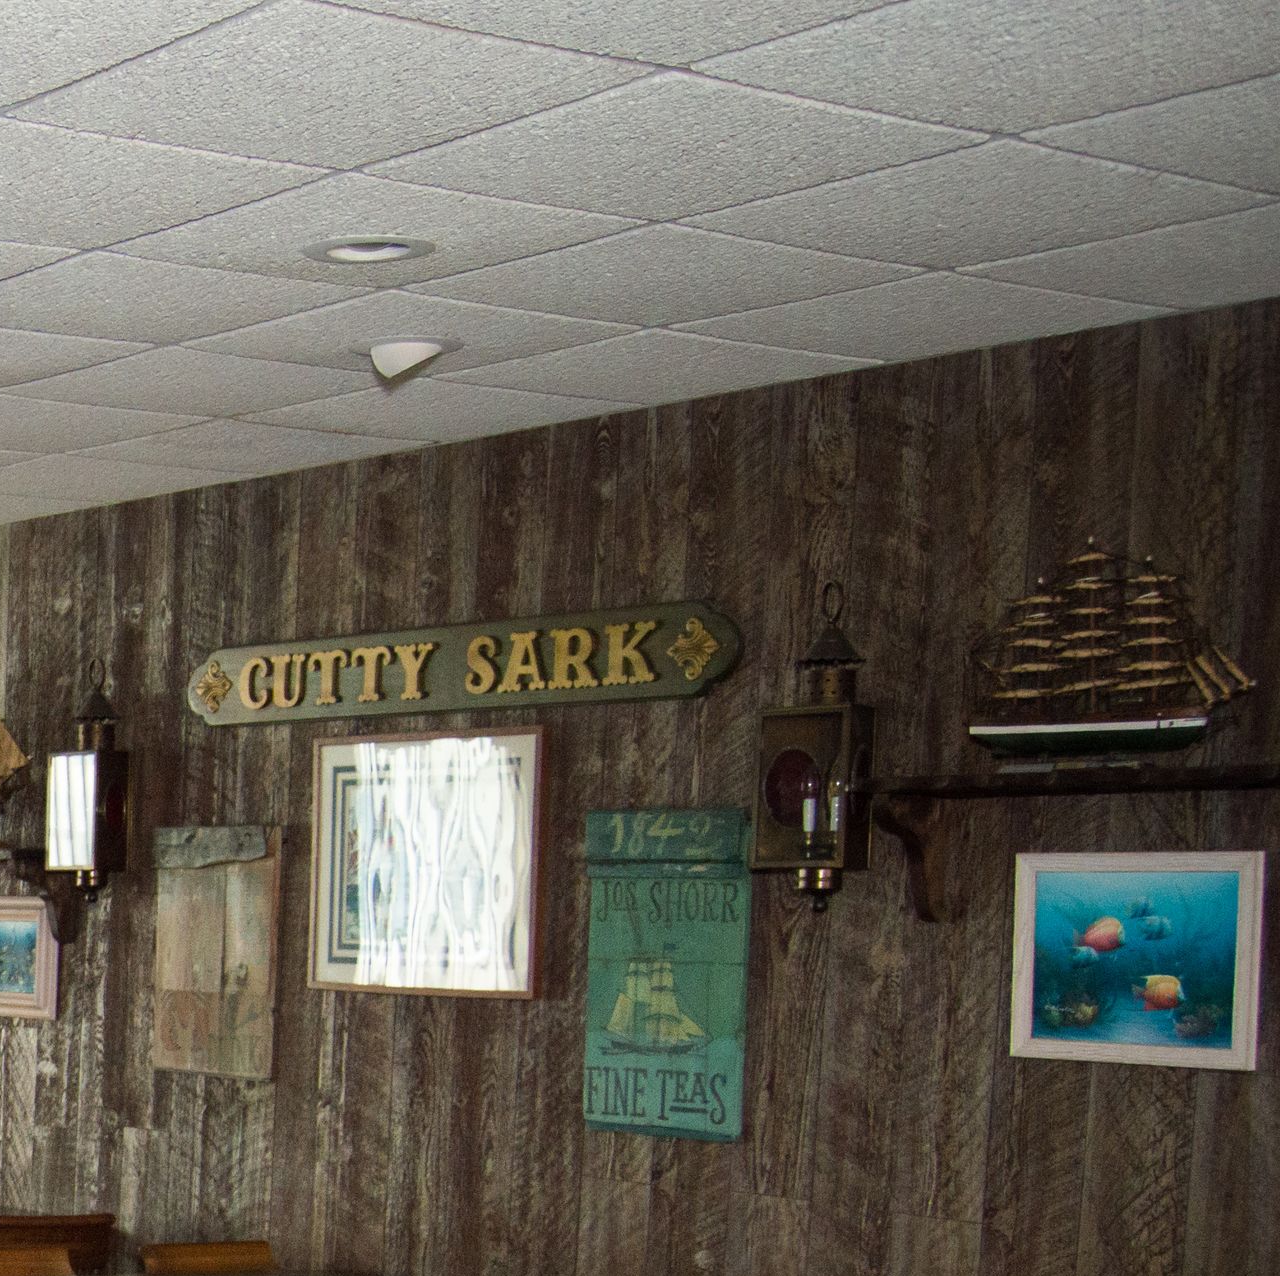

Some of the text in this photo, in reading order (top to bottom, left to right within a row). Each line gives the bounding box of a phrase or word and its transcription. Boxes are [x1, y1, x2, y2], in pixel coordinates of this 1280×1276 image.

[239, 620, 657, 710] CUTTY SARK
[586, 1065, 727, 1125] FINE TEAS
